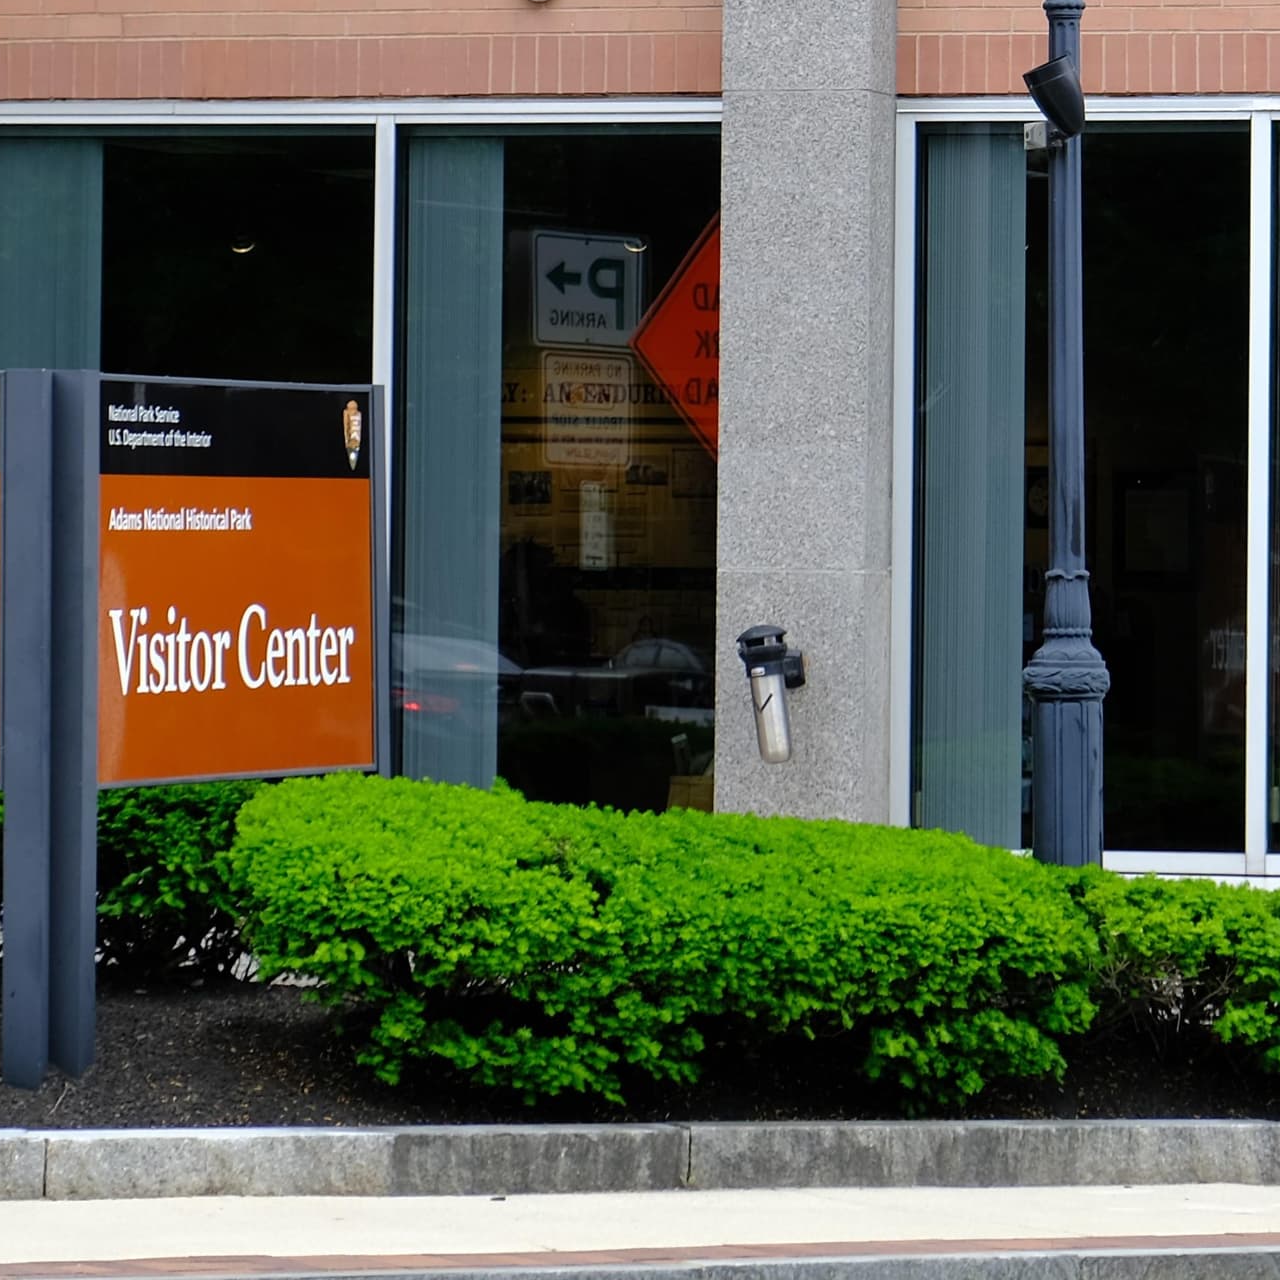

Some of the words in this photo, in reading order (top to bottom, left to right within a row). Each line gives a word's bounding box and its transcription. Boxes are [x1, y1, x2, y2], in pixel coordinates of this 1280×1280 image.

[108, 404, 138, 422] National
[138, 405, 155, 423] Park
[155, 405, 180, 424] Service
[108, 428, 122, 446] U.S.
[122, 428, 165, 450] Department
[165, 429, 174, 447] of
[174, 429, 186, 447] the
[186, 430, 212, 447] Interior
[108, 507, 142, 531] Adams
[143, 507, 185, 531] National
[185, 507, 230, 531] Historical
[230, 507, 252, 531] Park
[108, 605, 232, 696] Visitor
[238, 603, 355, 690] Center
